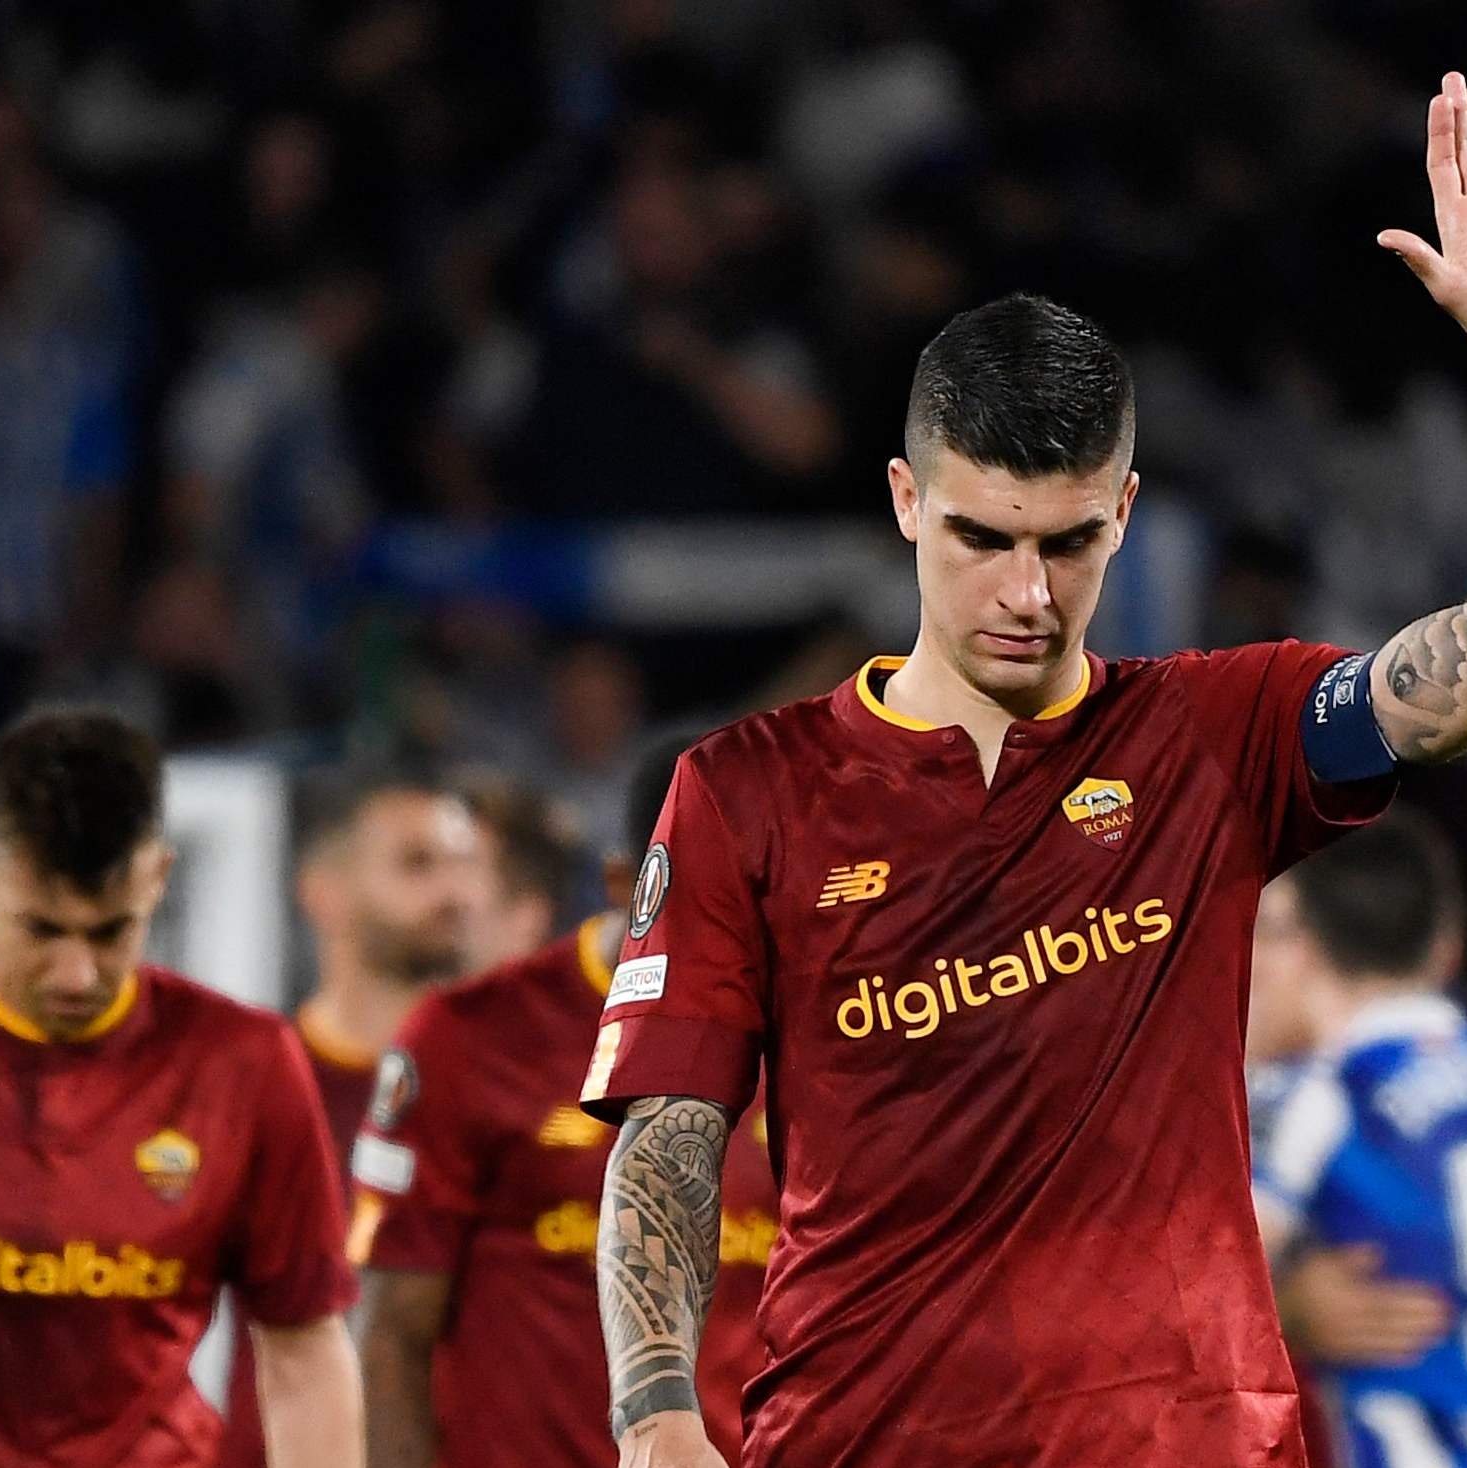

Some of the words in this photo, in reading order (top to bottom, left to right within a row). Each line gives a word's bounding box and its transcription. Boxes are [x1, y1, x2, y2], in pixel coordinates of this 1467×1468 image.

[1318, 669, 1338, 691] TO
[1315, 692, 1328, 724] NO
[1082, 812, 1133, 837] ROMA
[836, 897, 1173, 1039] digitalbits
